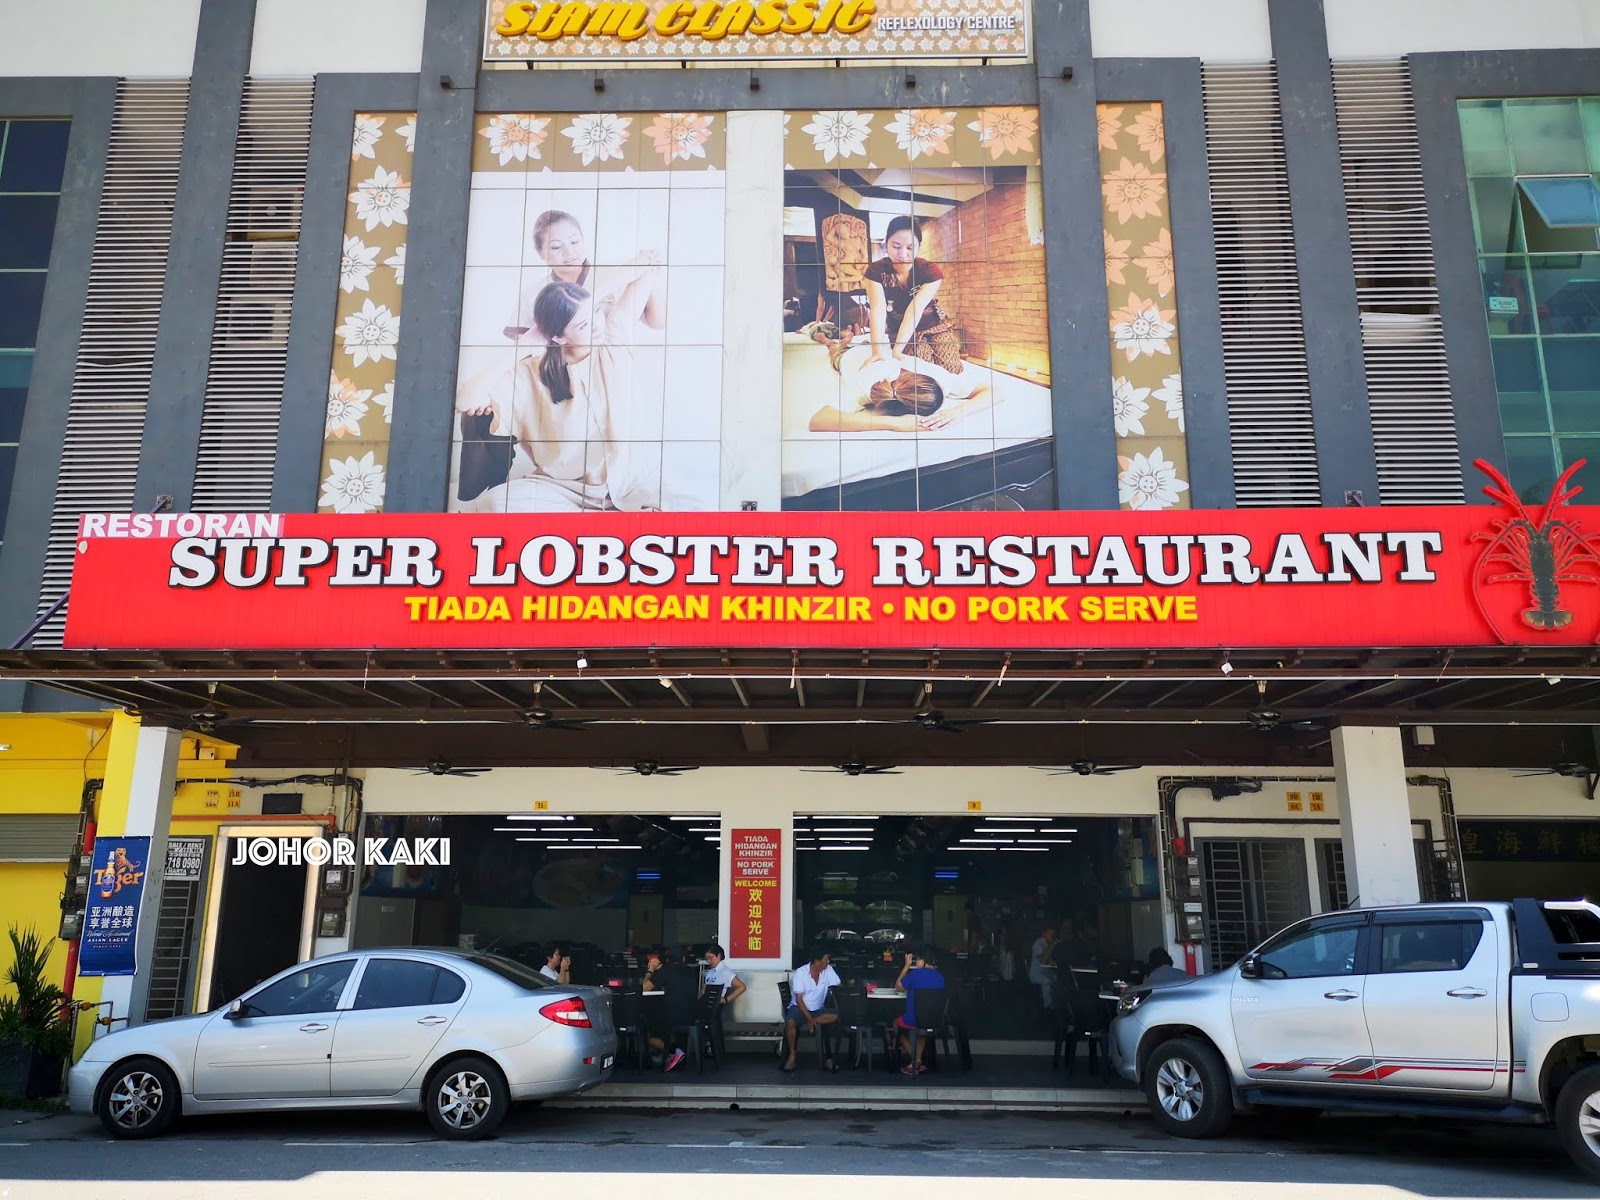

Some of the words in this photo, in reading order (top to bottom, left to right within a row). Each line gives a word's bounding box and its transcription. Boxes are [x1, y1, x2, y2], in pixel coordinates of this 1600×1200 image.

[496, 0, 651, 42] SIAM
[653, 0, 877, 41] CLASSIC
[877, 16, 963, 31] REFLEXOLOGY
[966, 15, 1016, 30] CENTRE
[82, 513, 280, 538] RESTORAN
[168, 536, 443, 588] SUPER
[469, 535, 846, 587] LOBSTER
[873, 532, 1443, 587] RESTAURANT
[404, 595, 511, 621] TIADA
[522, 595, 710, 621] HIDANGAN
[721, 595, 873, 622] KHINZIR
[904, 596, 956, 622] NO
[968, 596, 1069, 622] PORK
[1080, 595, 1199, 622] SERVE
[734, 842, 778, 850] HIDANGAN
[743, 835, 769, 843] TIADA
[738, 849, 774, 857] KHINZIR
[734, 880, 778, 888] WELCOME
[88, 917, 133, 929] 享誉全球
[748, 888, 763, 951] 欢迎光临
